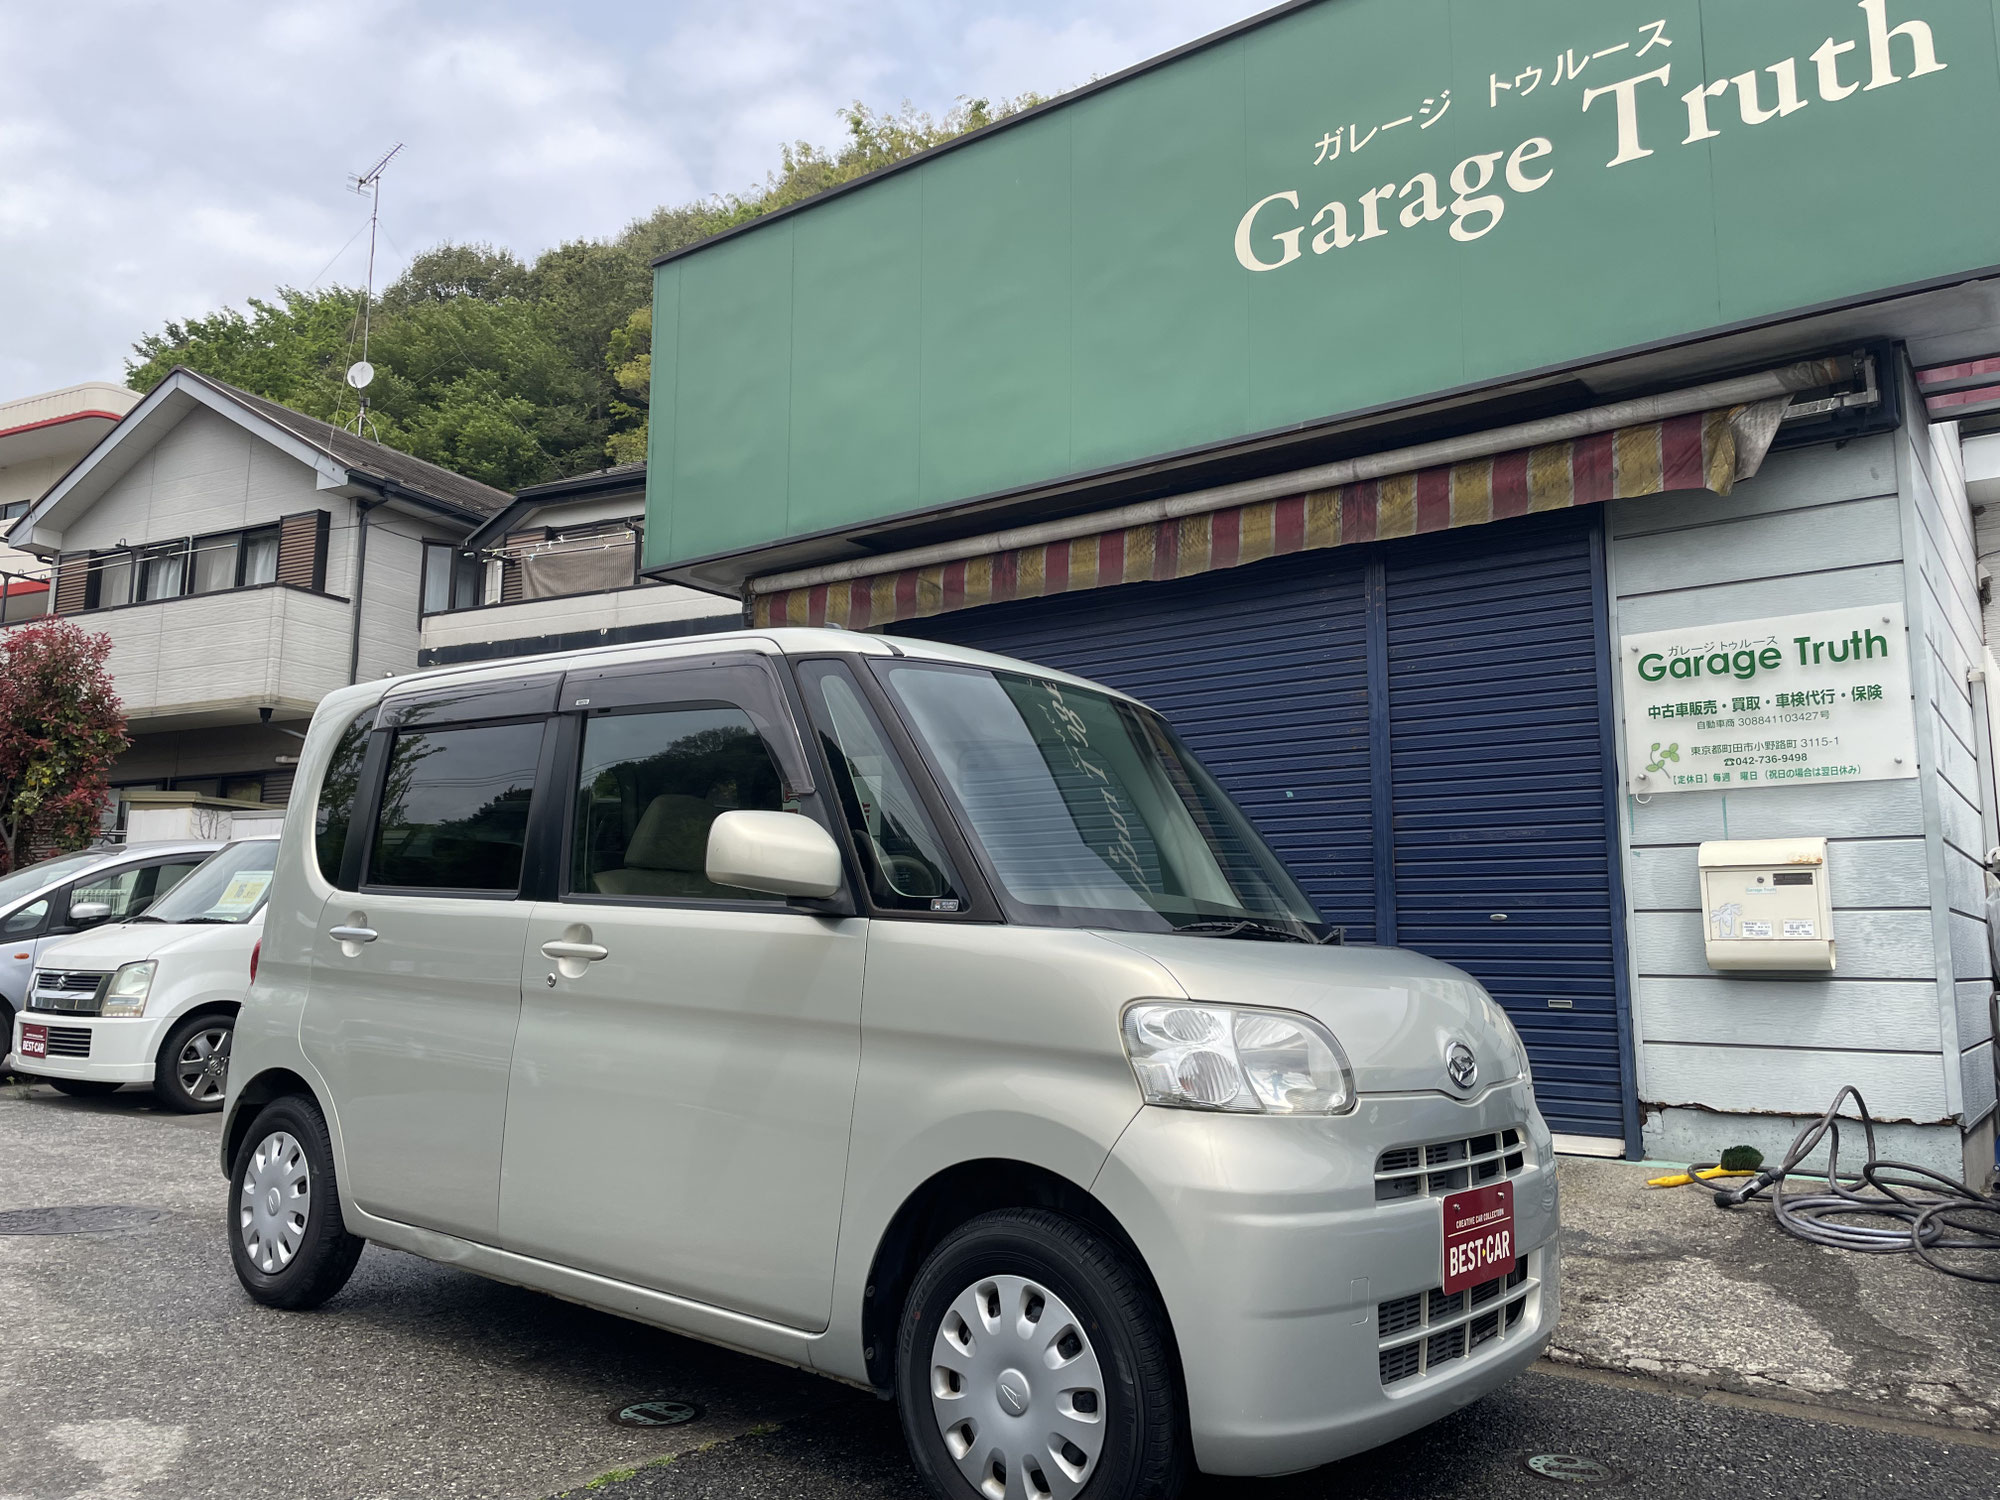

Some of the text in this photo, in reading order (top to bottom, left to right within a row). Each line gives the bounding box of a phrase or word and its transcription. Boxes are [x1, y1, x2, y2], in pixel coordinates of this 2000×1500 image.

[1312, 19, 1674, 166] ガレージ トゥルース
[1234, 0, 1948, 272] Garage Truth
[1638, 628, 1888, 681] Garage Truth
[1667, 635, 1778, 657] ガレージ トゥルース
[1690, 736, 1840, 756] 東京都町田市小野路町 3115-1
